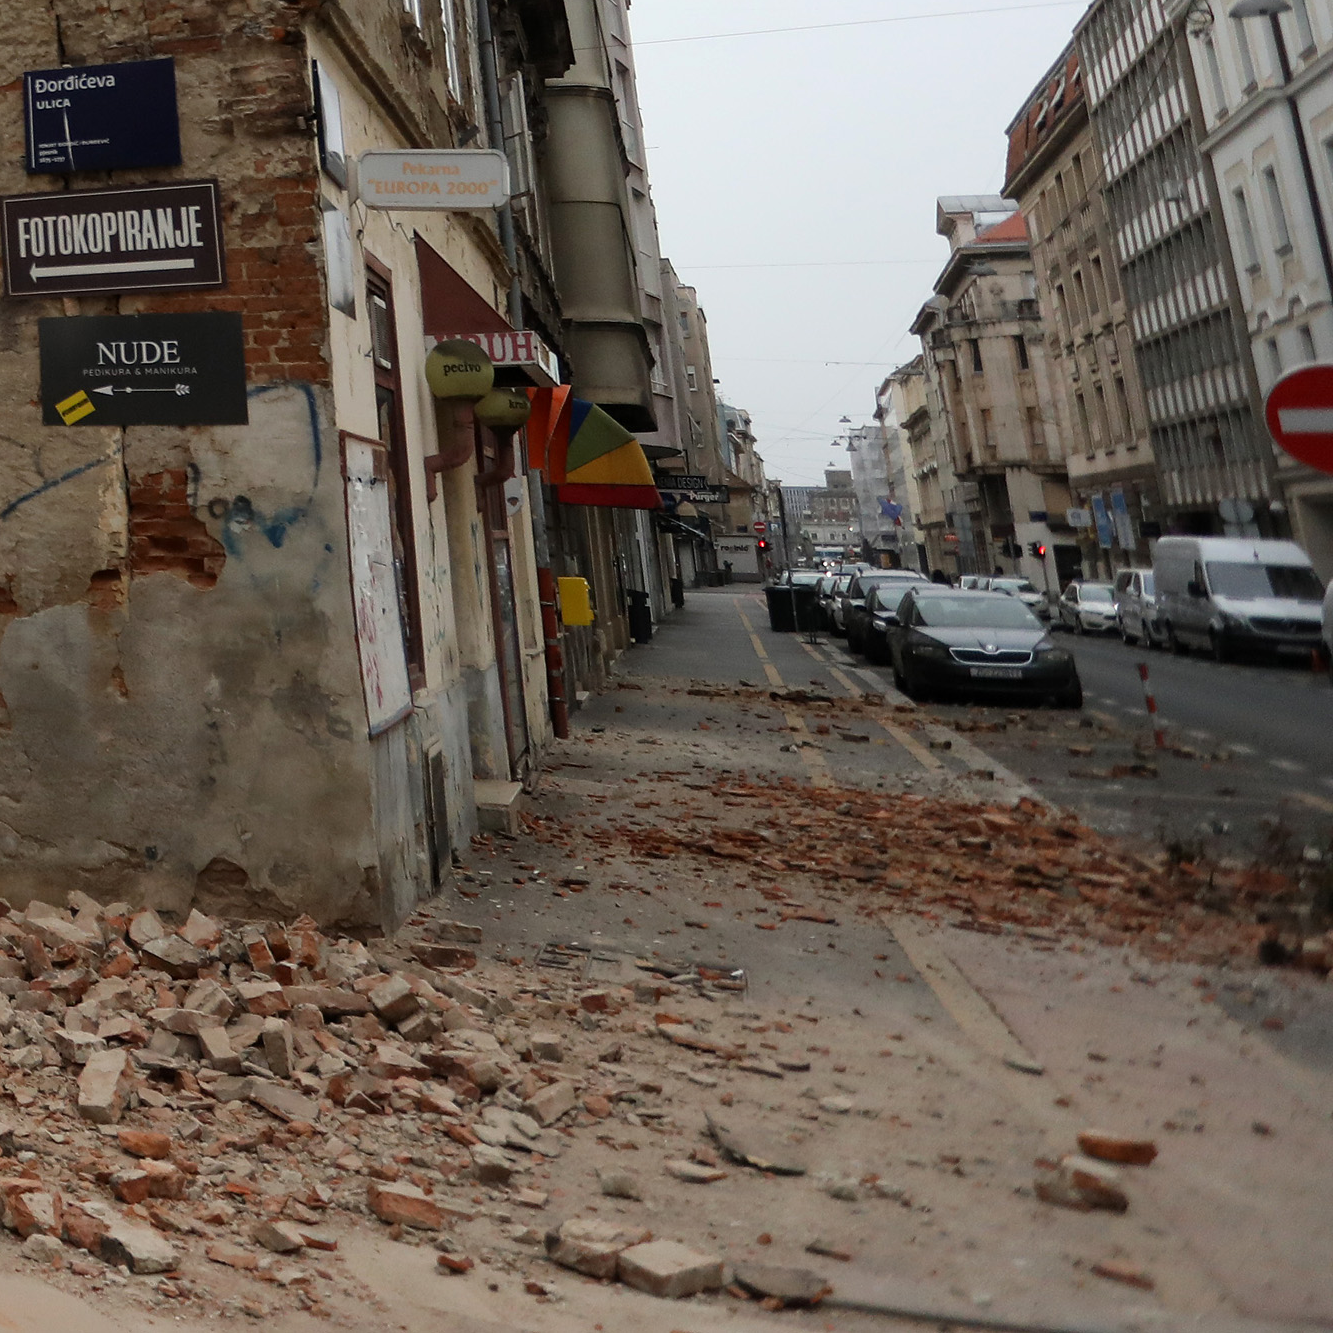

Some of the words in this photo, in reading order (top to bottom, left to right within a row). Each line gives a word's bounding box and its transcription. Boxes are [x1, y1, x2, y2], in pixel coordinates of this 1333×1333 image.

[35, 73, 116, 94] Đorđićeva
[36, 98, 72, 110] ULICA
[402, 162, 461, 175] Pekarna
[17, 205, 204, 258] FOTOKOPIRANJE
[96, 340, 181, 366] NUDE
[83, 368, 131, 377] PEDIKURA
[135, 368, 142, 376] &
[145, 366, 198, 375] MANIKURA
[443, 362, 481, 376] pecivo
